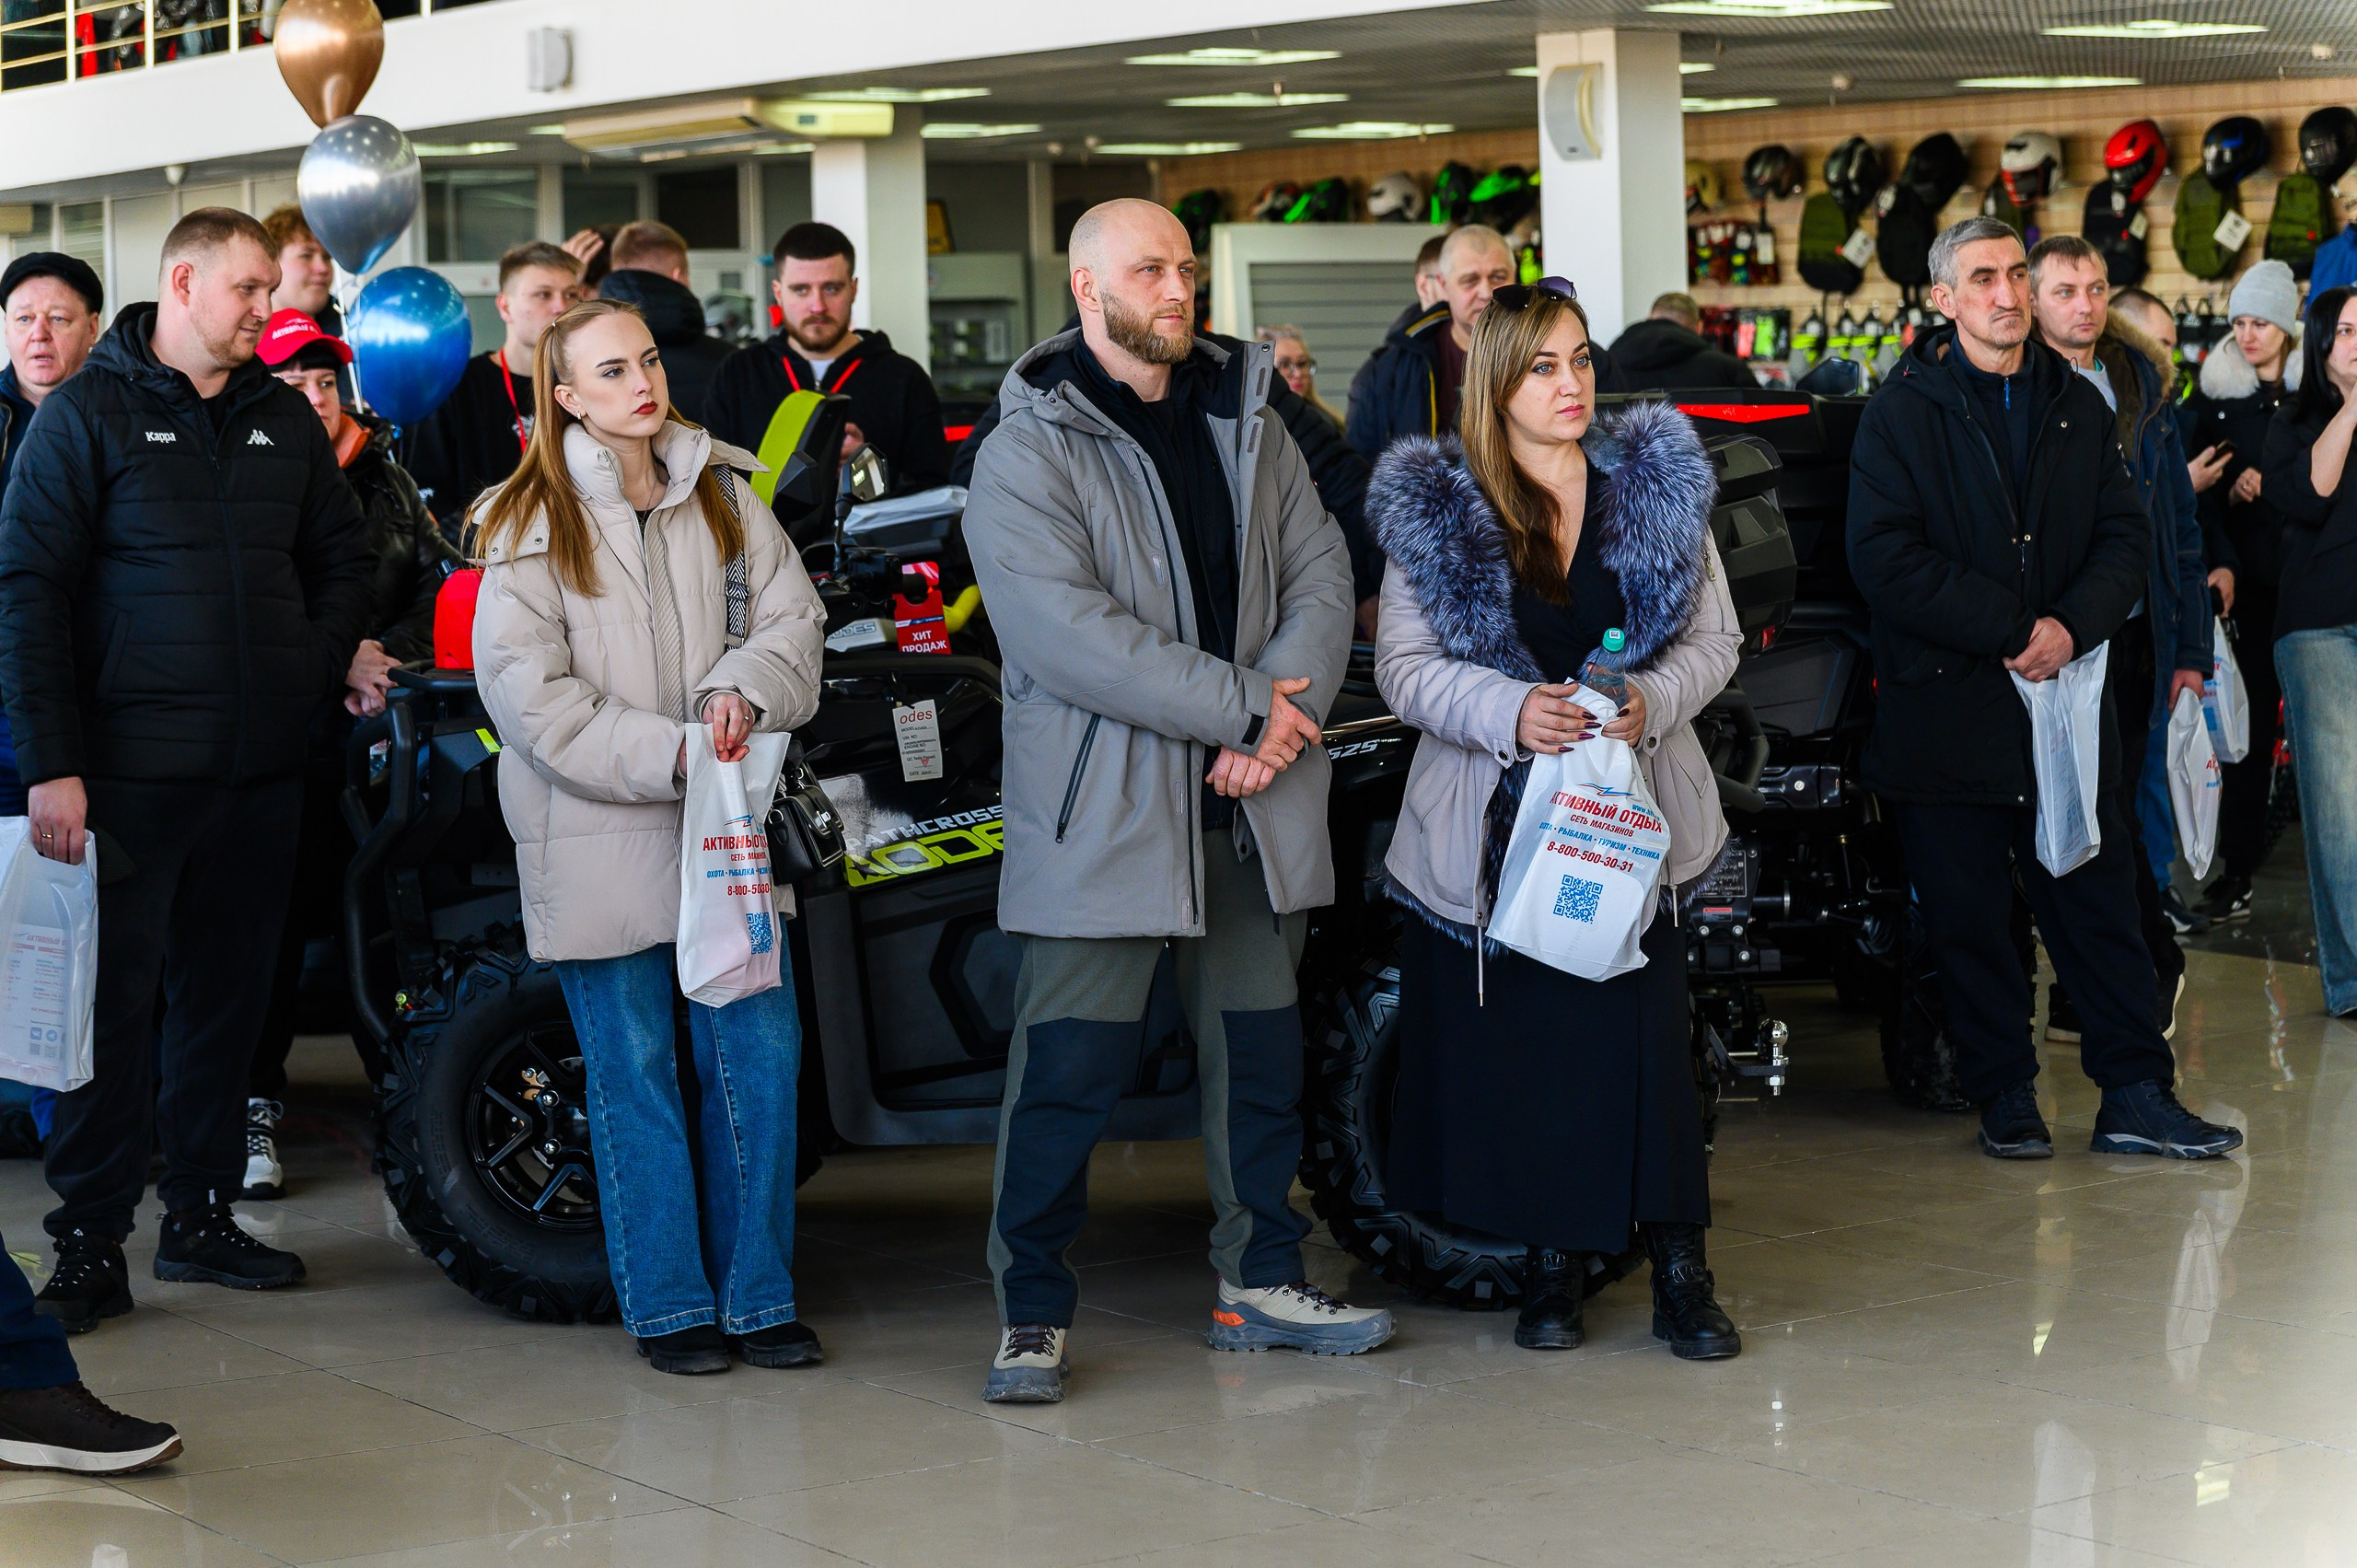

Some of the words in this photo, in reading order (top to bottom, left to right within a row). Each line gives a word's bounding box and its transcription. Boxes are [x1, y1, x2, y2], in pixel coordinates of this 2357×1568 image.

[145, 431, 176, 444] Kappa
[828, 621, 877, 640] ODES
[911, 630, 932, 642] ХИТ
[901, 640, 947, 654] ПРОДАЖ
[900, 710, 934, 725] odes
[1328, 738, 1380, 760] 525
[1570, 814, 1588, 825] СЕТЬ
[1590, 819, 1634, 838] МАГАЗИНОВ
[1619, 809, 1663, 833] ОТДЫХ
[844, 819, 1004, 887] AODE
[1558, 827, 1593, 842] РЫБАЛКА
[1597, 837, 1627, 852] ТУРИЗМ
[1631, 846, 1660, 860] ТЕХНИКА
[731, 853, 745, 861] СЕТЬ
[1547, 841, 1634, 873] 8-800-500-30-31
[707, 869, 725, 878] ОХОТА
[728, 867, 755, 877] РЫБАЛКА
